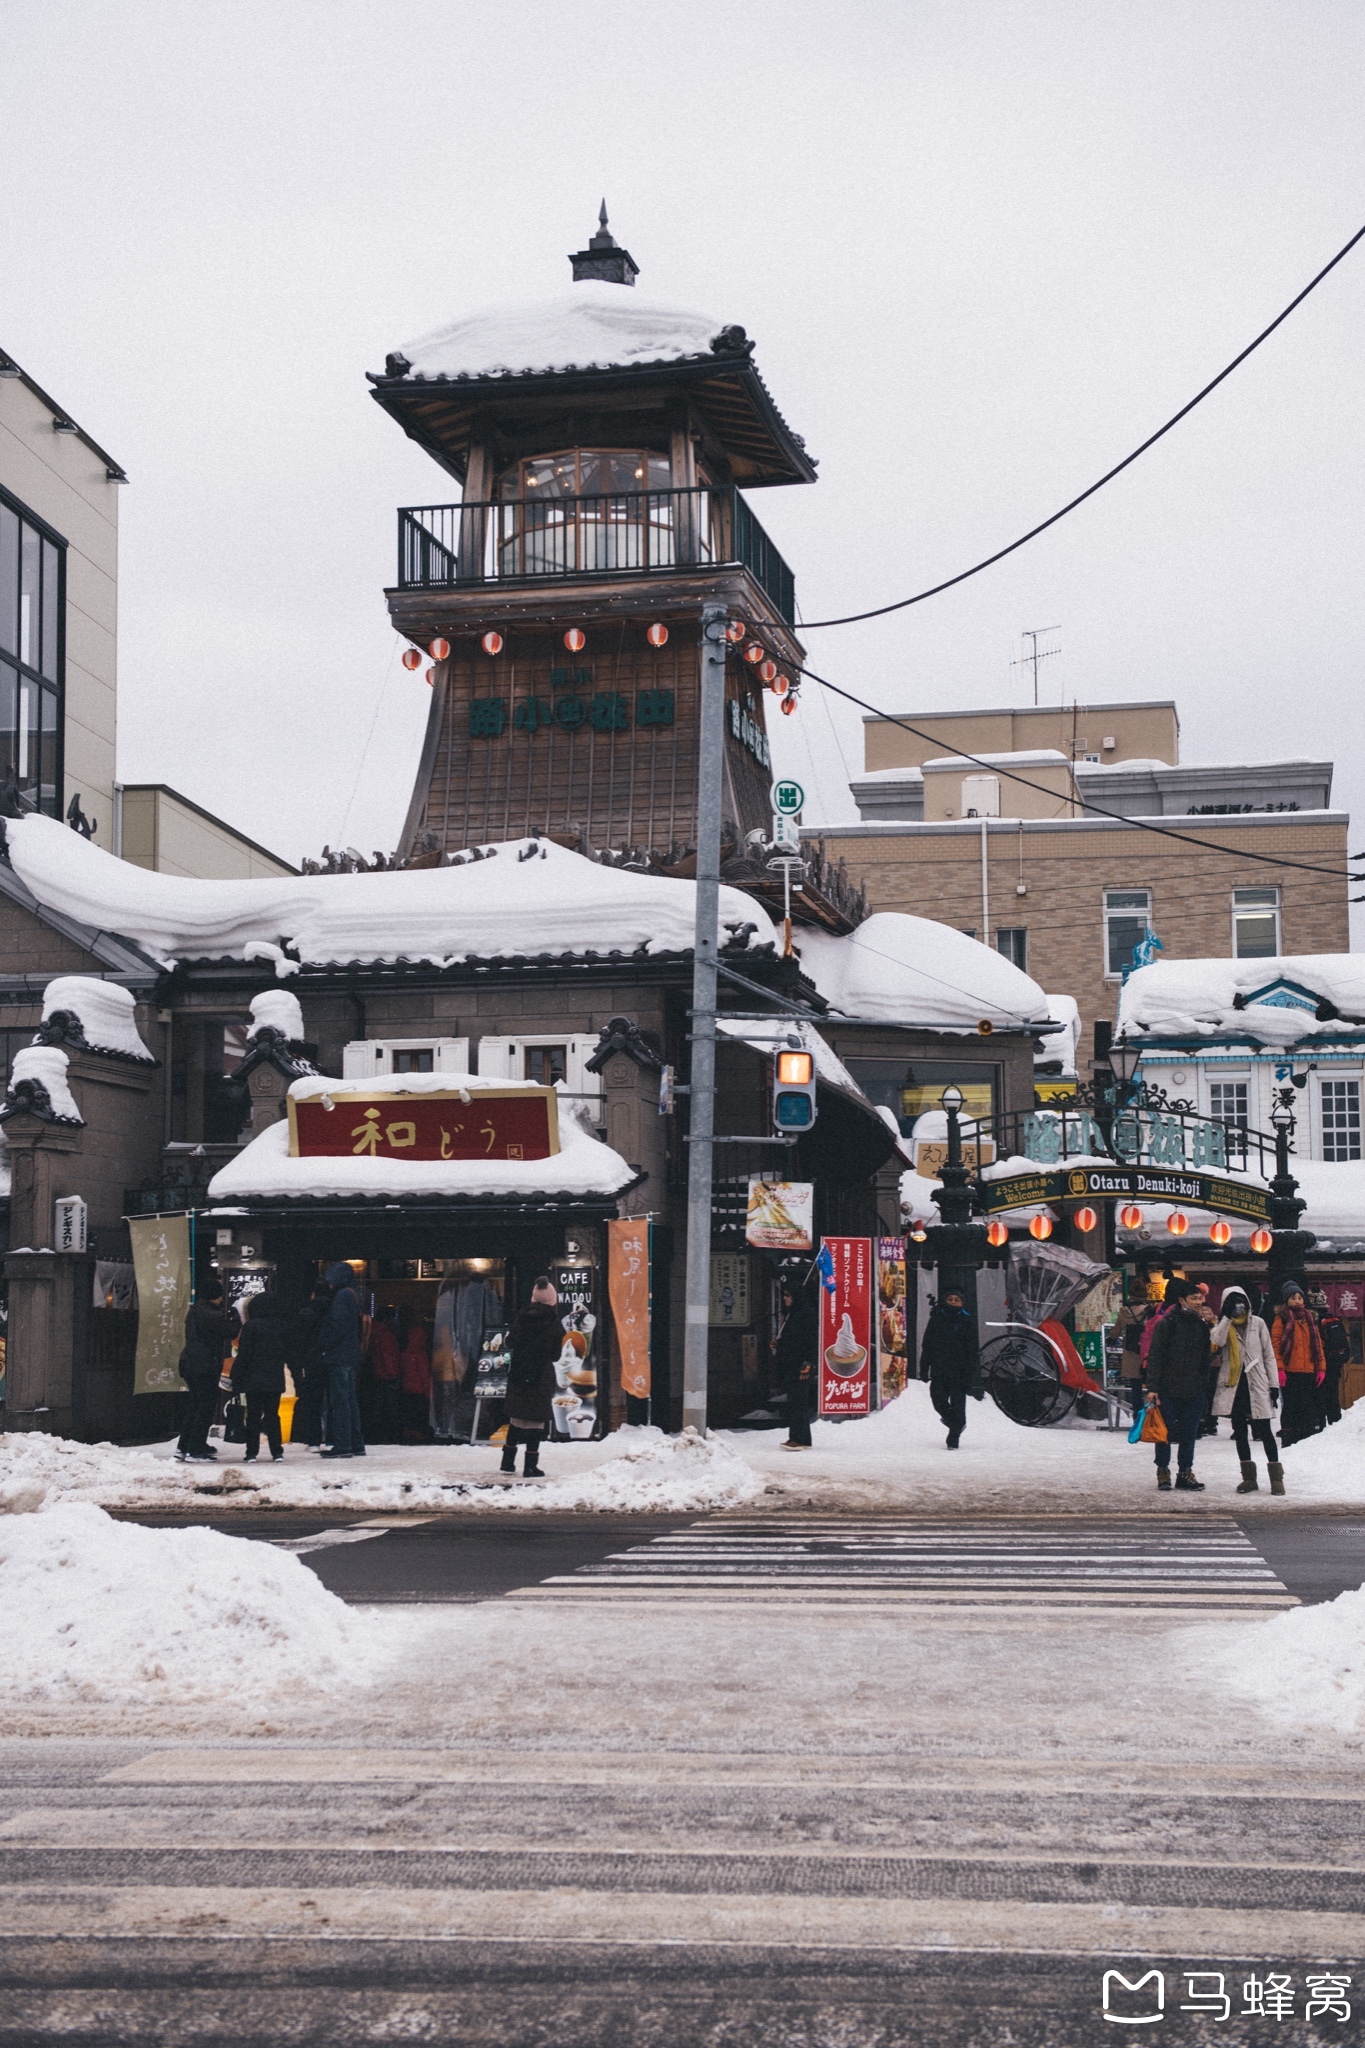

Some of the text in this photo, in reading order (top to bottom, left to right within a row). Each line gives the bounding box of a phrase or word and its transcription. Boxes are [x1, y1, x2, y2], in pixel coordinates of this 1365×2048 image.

[1090, 1174, 1200, 1198] Otaru Denuki-koji
[1005, 1189, 1046, 1203] Welcome
[62, 1206, 73, 1249] ジンギスカン
[560, 1272, 589, 1285] CAFE
[558, 1292, 592, 1304] WADOU
